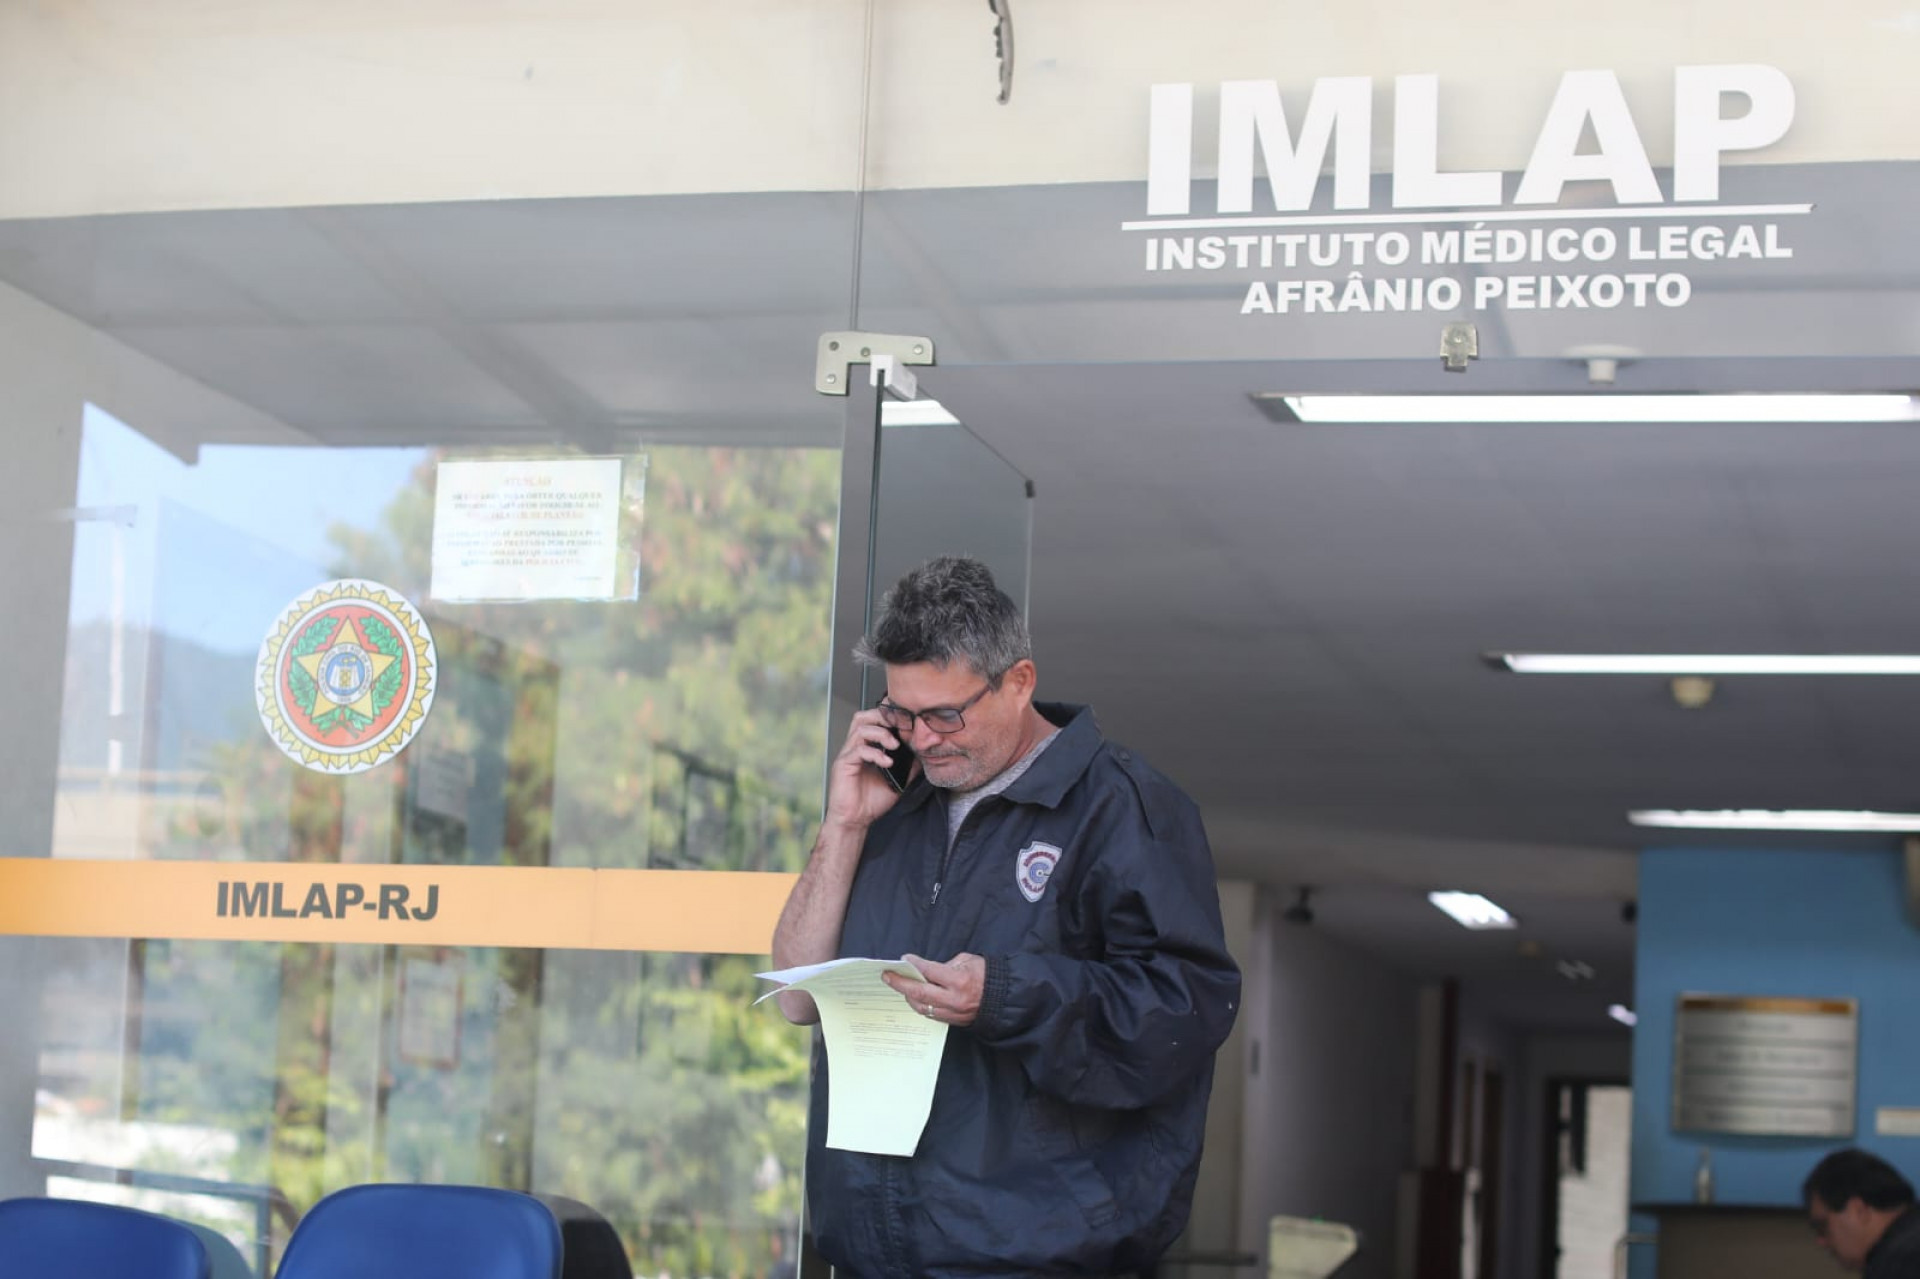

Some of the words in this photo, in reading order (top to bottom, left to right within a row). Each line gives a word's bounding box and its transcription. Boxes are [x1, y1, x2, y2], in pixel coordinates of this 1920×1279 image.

[1146, 63, 1796, 216] IMLAP
[1145, 231, 1411, 271] INSTITUTO
[1421, 222, 1617, 265] MÉDICO
[1628, 224, 1794, 260] LEGAL
[1240, 271, 1462, 315] AFRÂNIO
[1474, 272, 1692, 310] PEIXOTO
[216, 881, 440, 921] IMLAP-RJ
